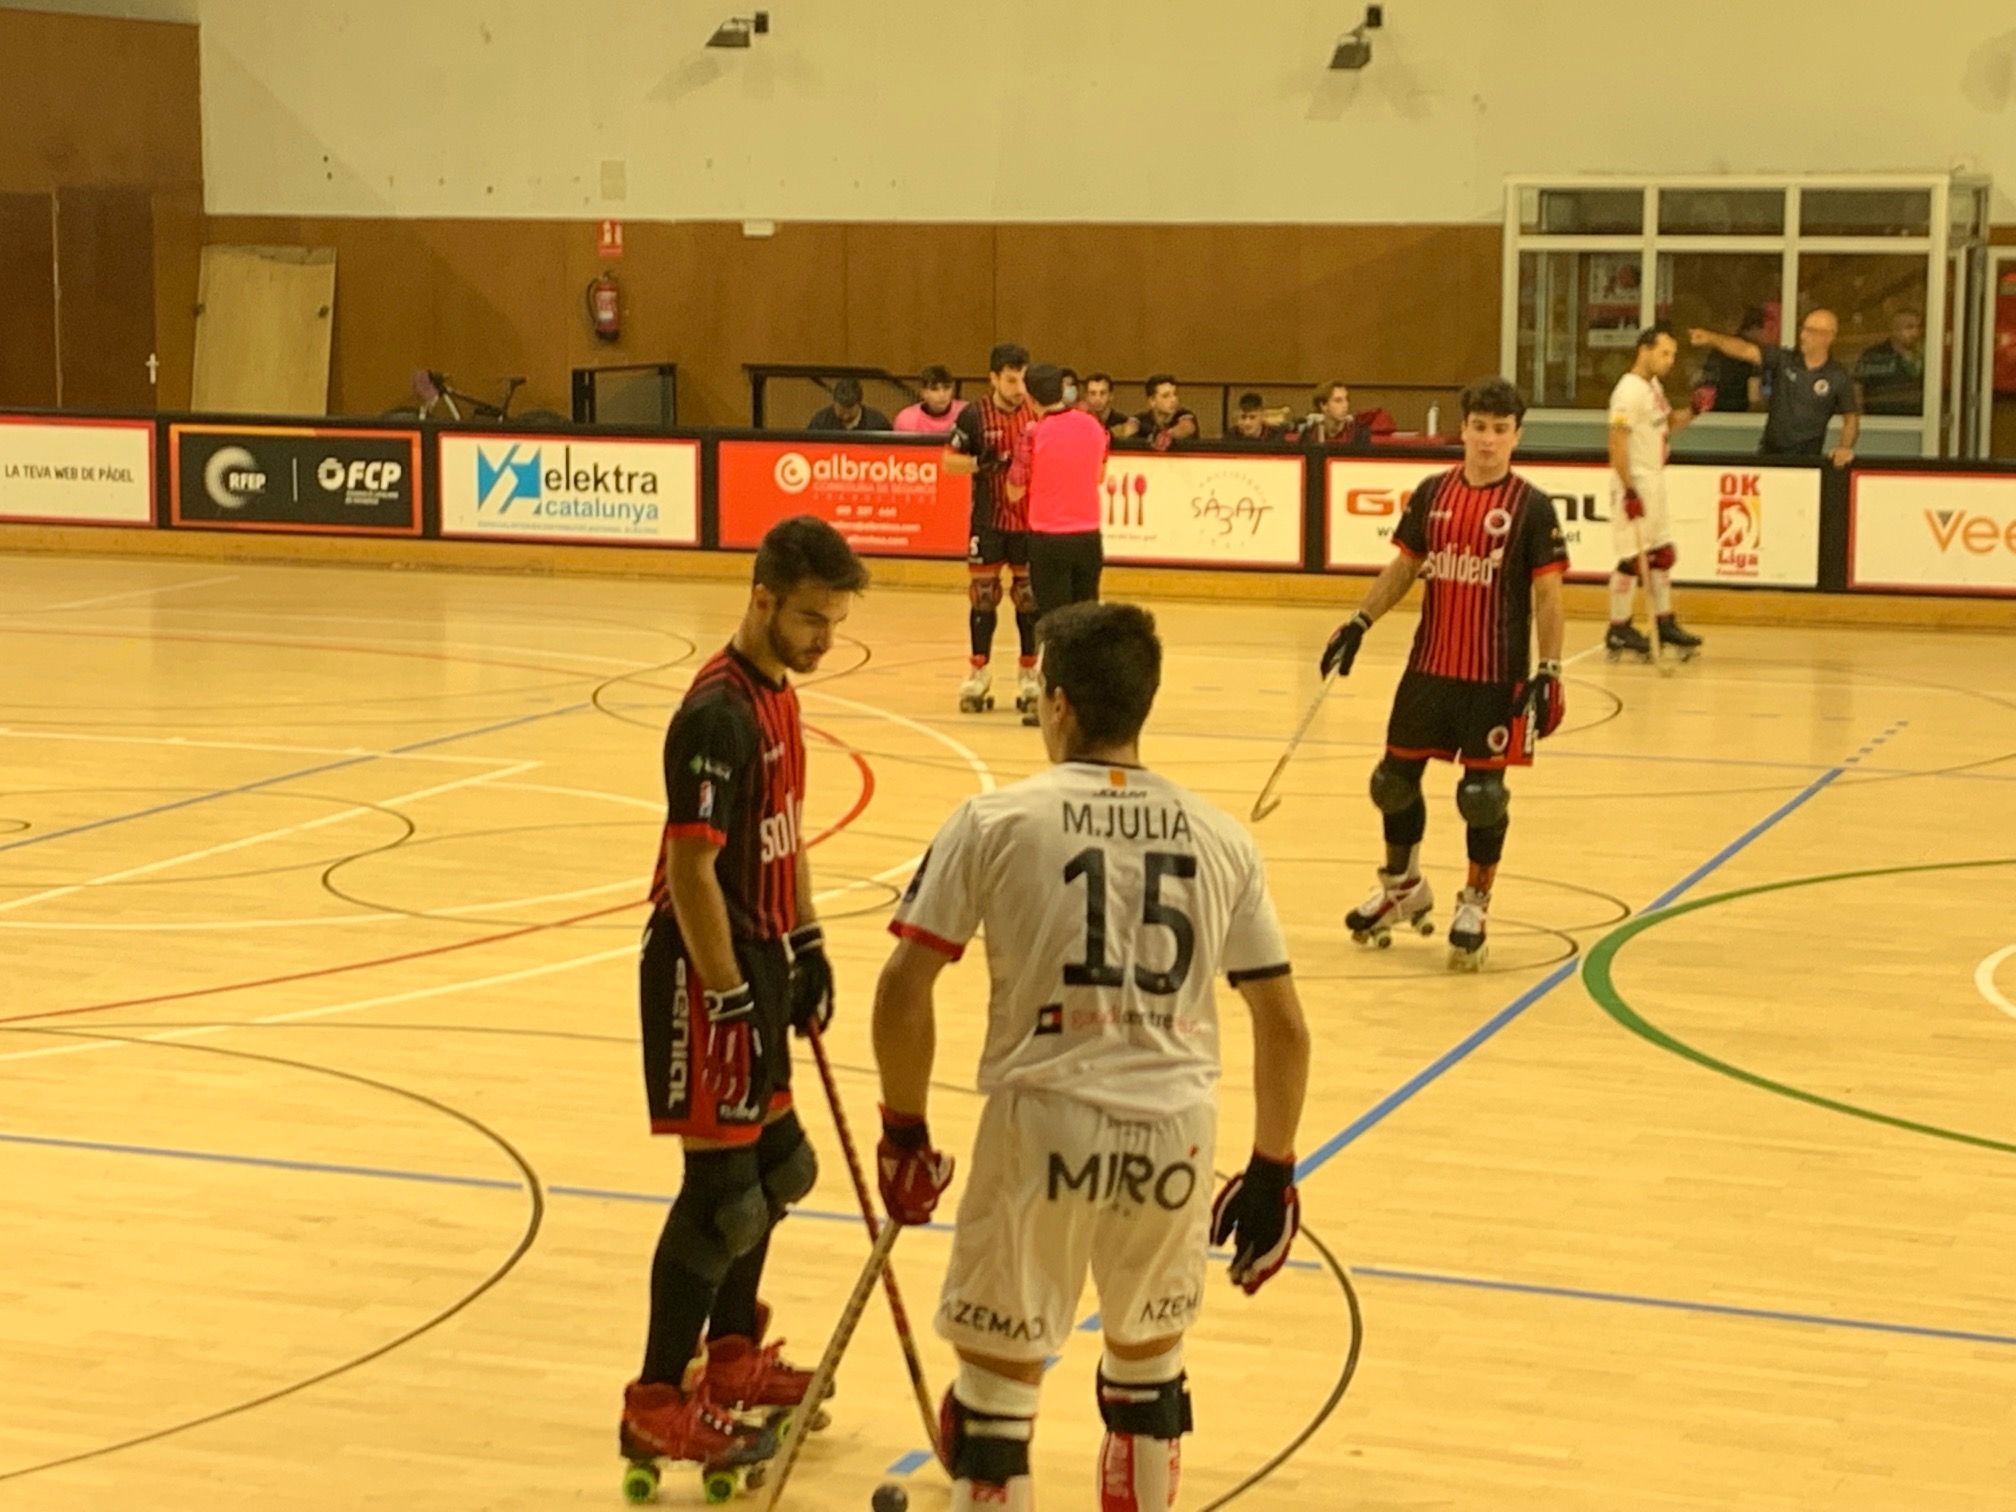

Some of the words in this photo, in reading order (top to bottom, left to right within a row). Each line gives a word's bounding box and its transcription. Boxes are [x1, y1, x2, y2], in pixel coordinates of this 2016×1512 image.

[5, 464, 20, 478] LA
[23, 464, 51, 479] TEVA
[54, 466, 78, 480] WEB
[82, 467, 95, 481] DE
[229, 472, 266, 490] RFEP
[347, 461, 401, 490] FCP
[544, 444, 658, 494] elektra
[813, 453, 937, 483] albroksa
[1720, 473, 1760, 496] OK
[545, 498, 659, 524] catalunya
[1426, 543, 1494, 585] solideo
[1718, 548, 1758, 568] Liga
[1063, 847, 1197, 995] 15
